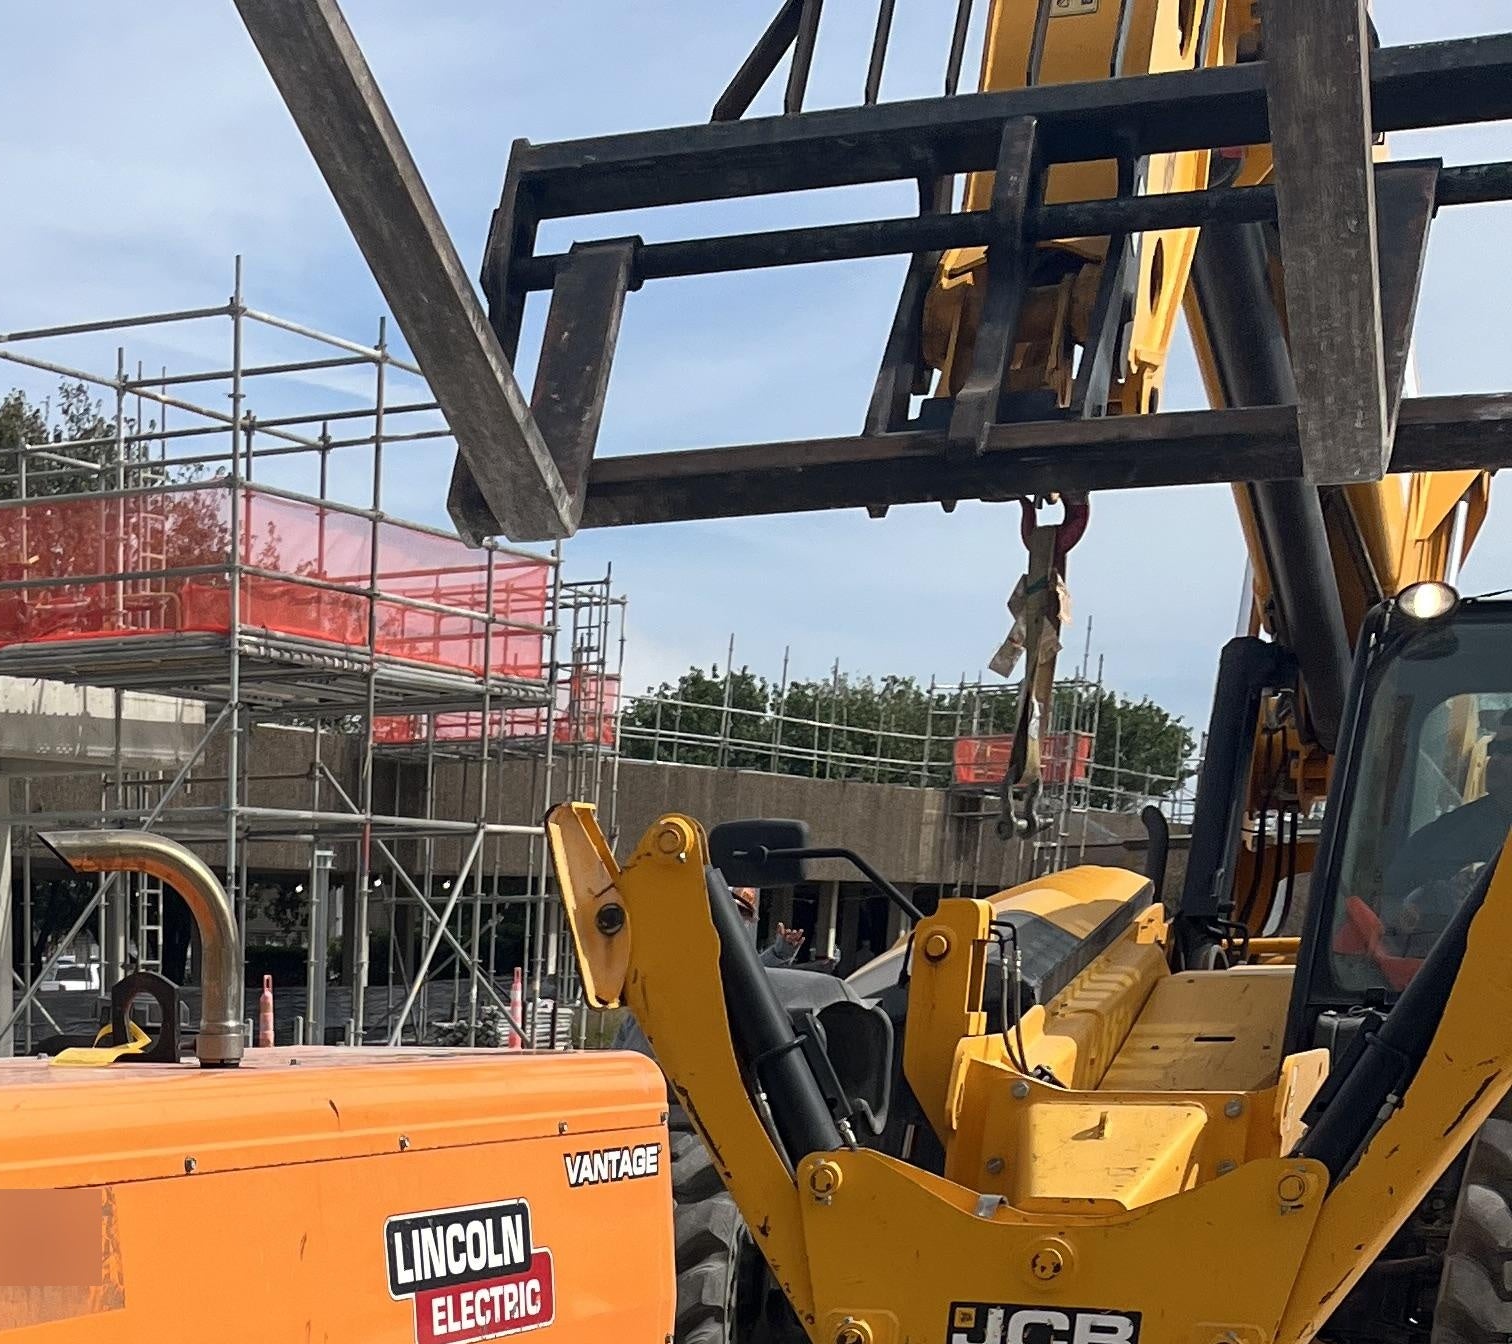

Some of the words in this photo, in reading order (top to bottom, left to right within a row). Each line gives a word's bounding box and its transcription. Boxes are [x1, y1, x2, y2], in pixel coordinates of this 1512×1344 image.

[563, 1143, 659, 1187] VANTAGE
[393, 1213, 525, 1285] LINCOLN
[431, 1278, 541, 1336] ELECTRIC
